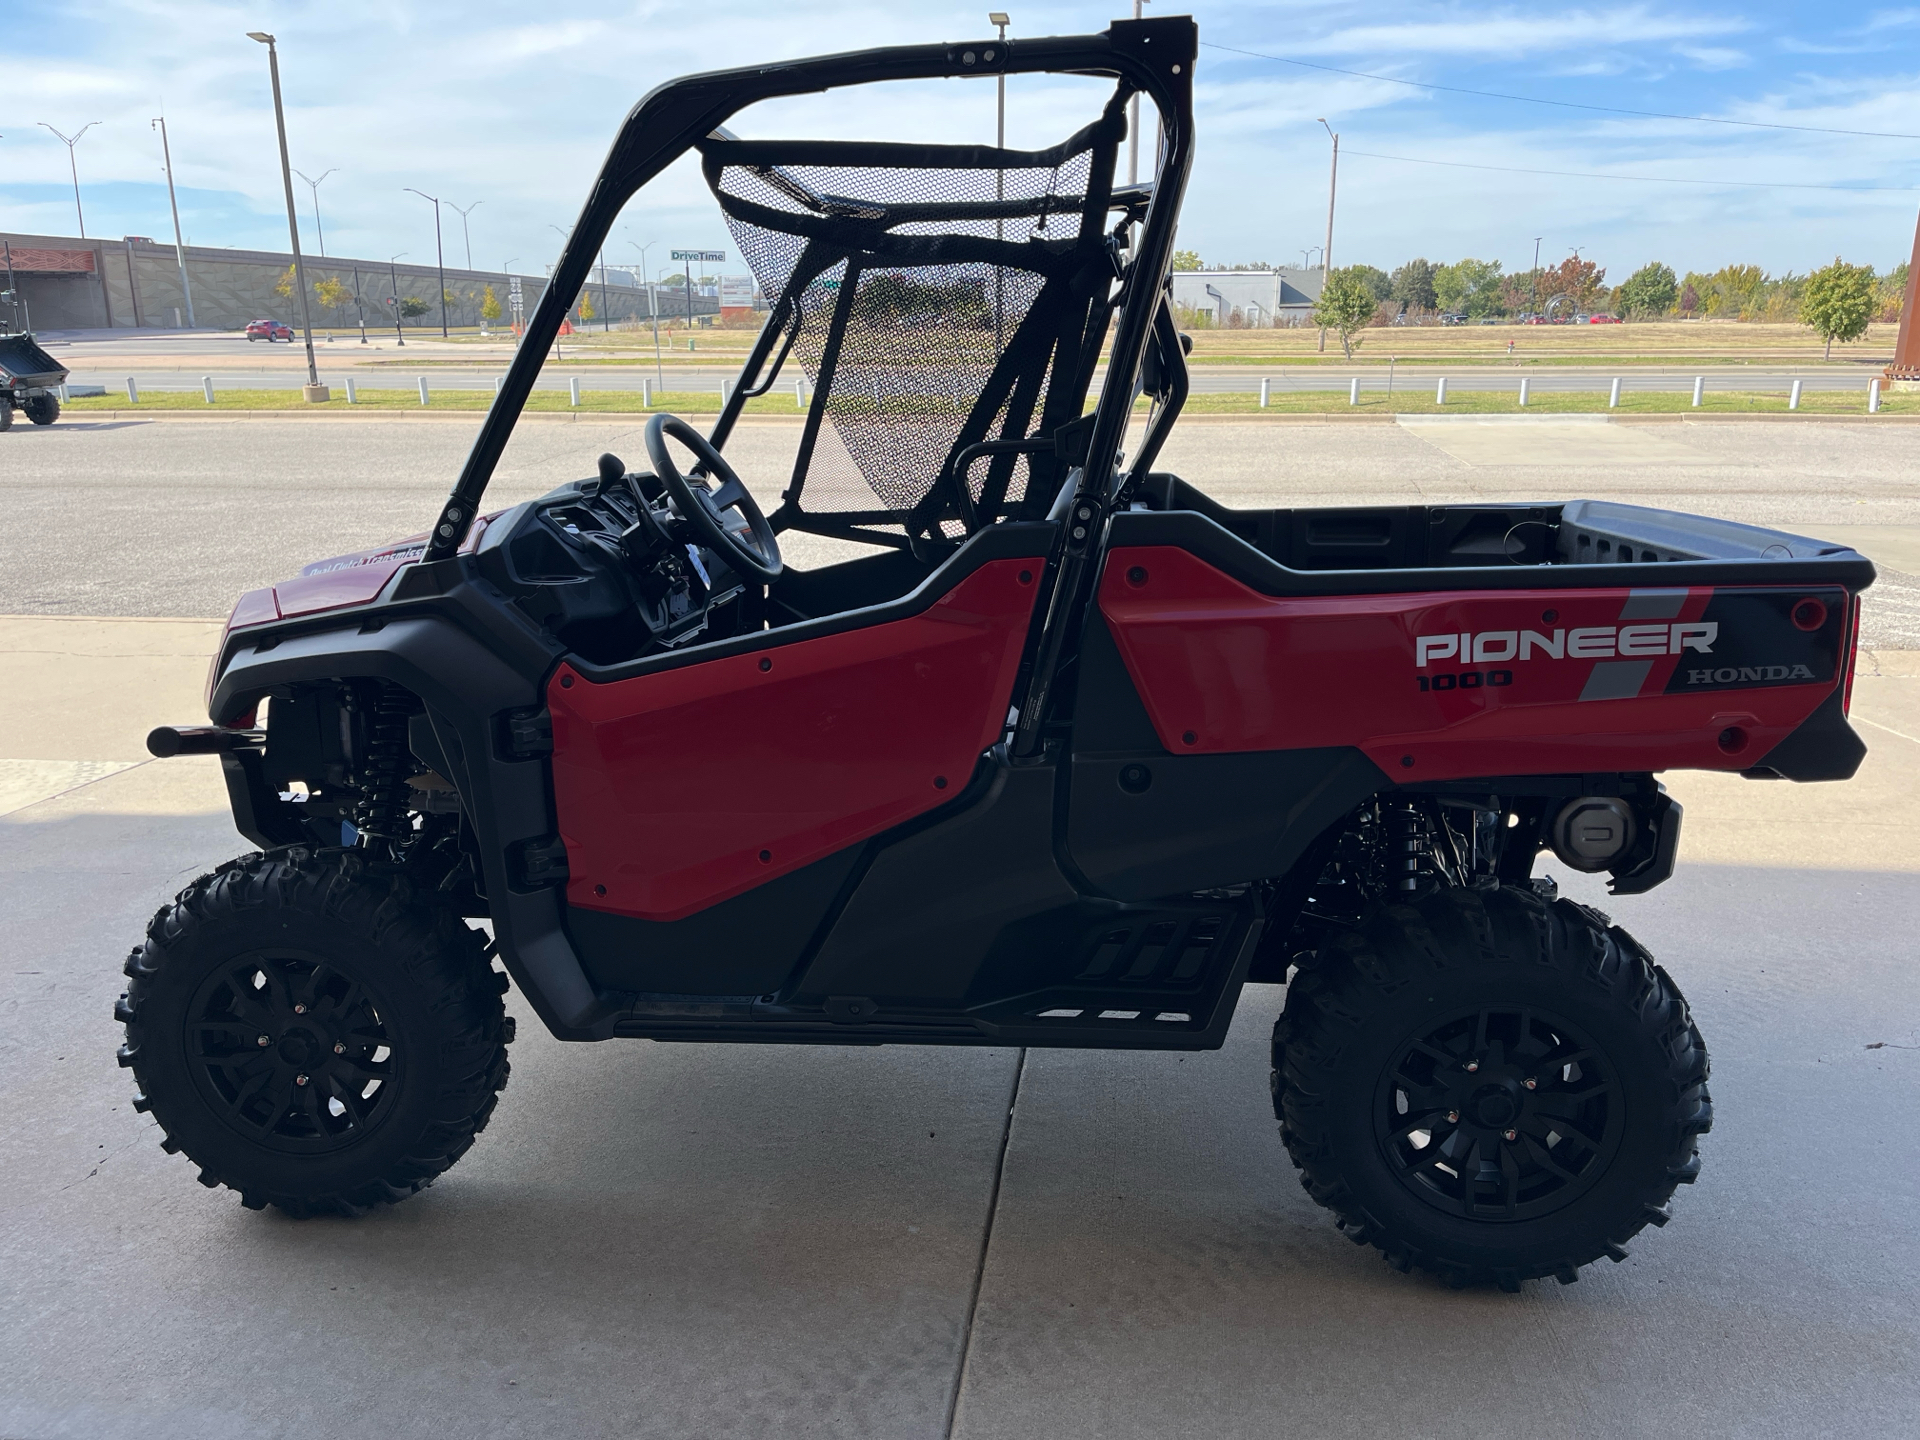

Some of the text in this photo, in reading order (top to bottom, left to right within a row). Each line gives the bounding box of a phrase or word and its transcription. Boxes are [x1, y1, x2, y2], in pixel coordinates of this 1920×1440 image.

[671, 251, 724, 261] DriveTime
[310, 565, 331, 576] Dual
[333, 557, 363, 571] Clutch
[1416, 622, 1718, 667] PIONEER
[1416, 670, 1513, 692] 1000
[1687, 664, 1815, 684] HONDA
